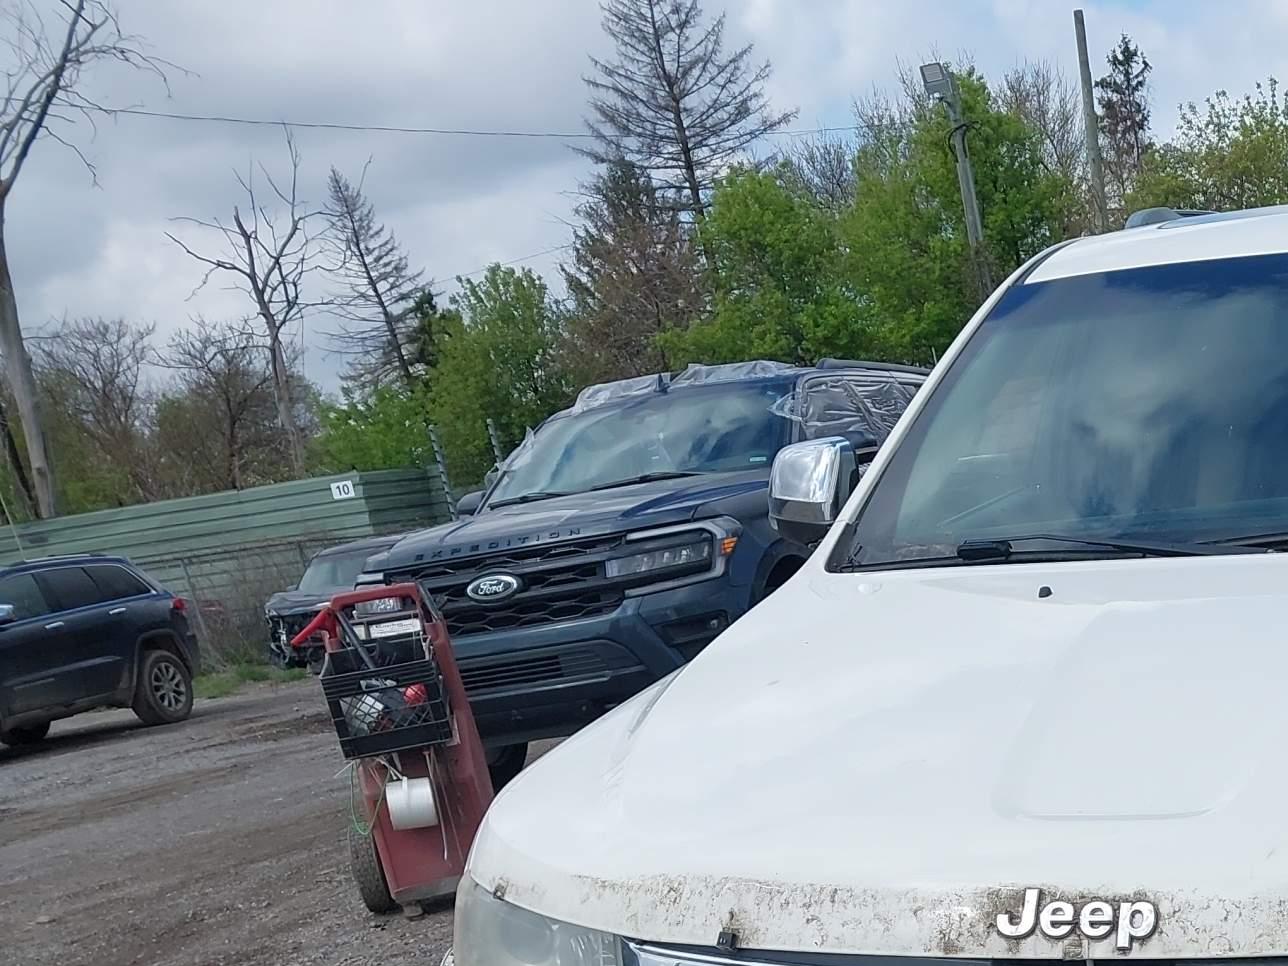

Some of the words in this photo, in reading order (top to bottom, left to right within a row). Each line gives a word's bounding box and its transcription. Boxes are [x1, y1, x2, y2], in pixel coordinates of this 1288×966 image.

[335, 484, 350, 496] 10
[413, 527, 581, 562] EXPEDITION
[477, 579, 505, 596] Ford
[996, 888, 1158, 950] Jeep
